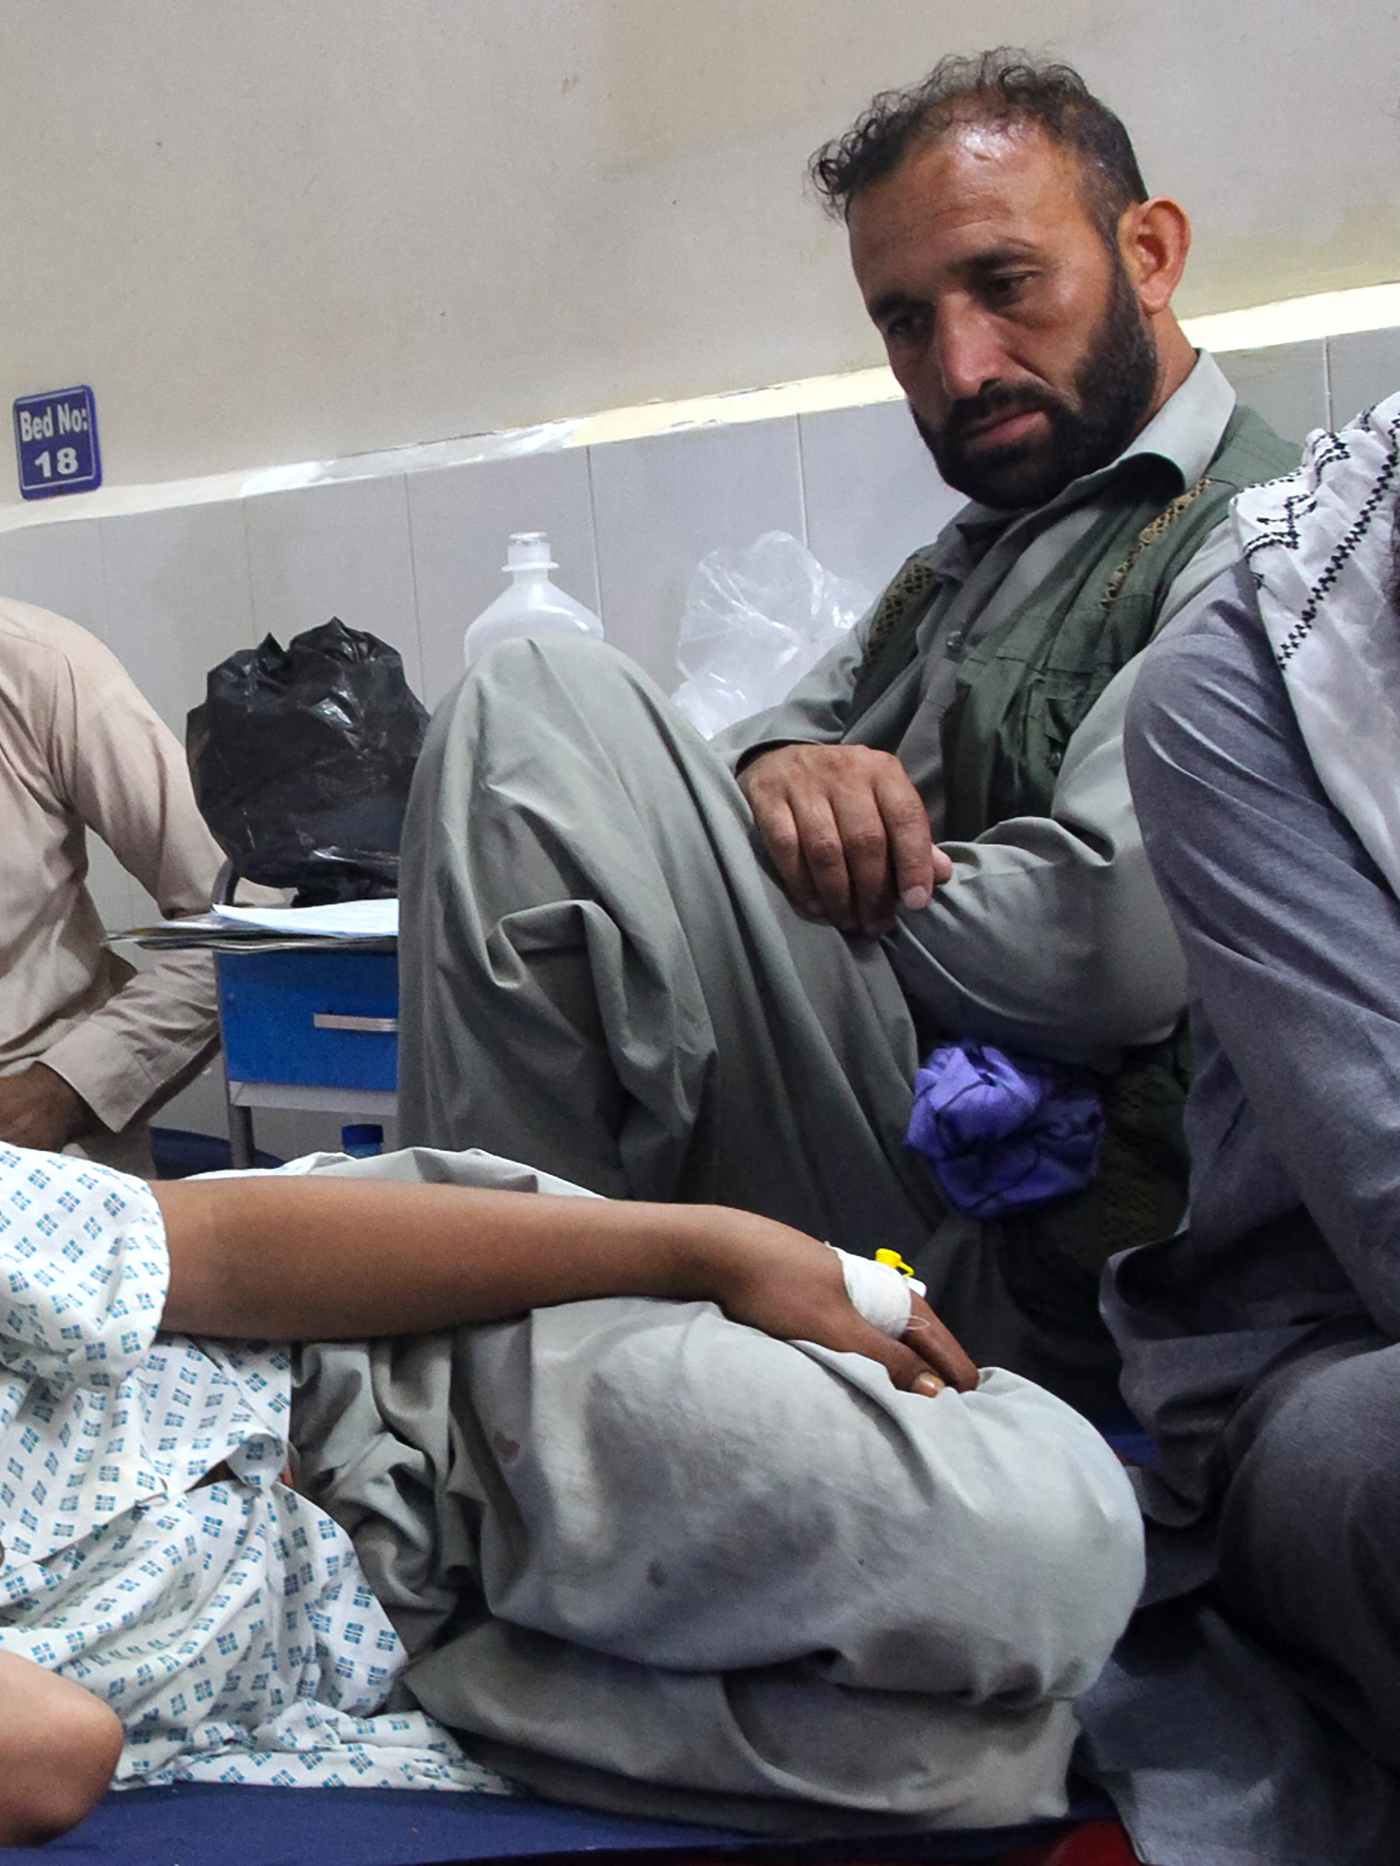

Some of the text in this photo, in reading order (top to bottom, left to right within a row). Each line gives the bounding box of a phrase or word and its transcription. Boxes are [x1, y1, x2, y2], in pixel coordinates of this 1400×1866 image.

[19, 402, 88, 442] Bed No:
[35, 447, 79, 478] 18
